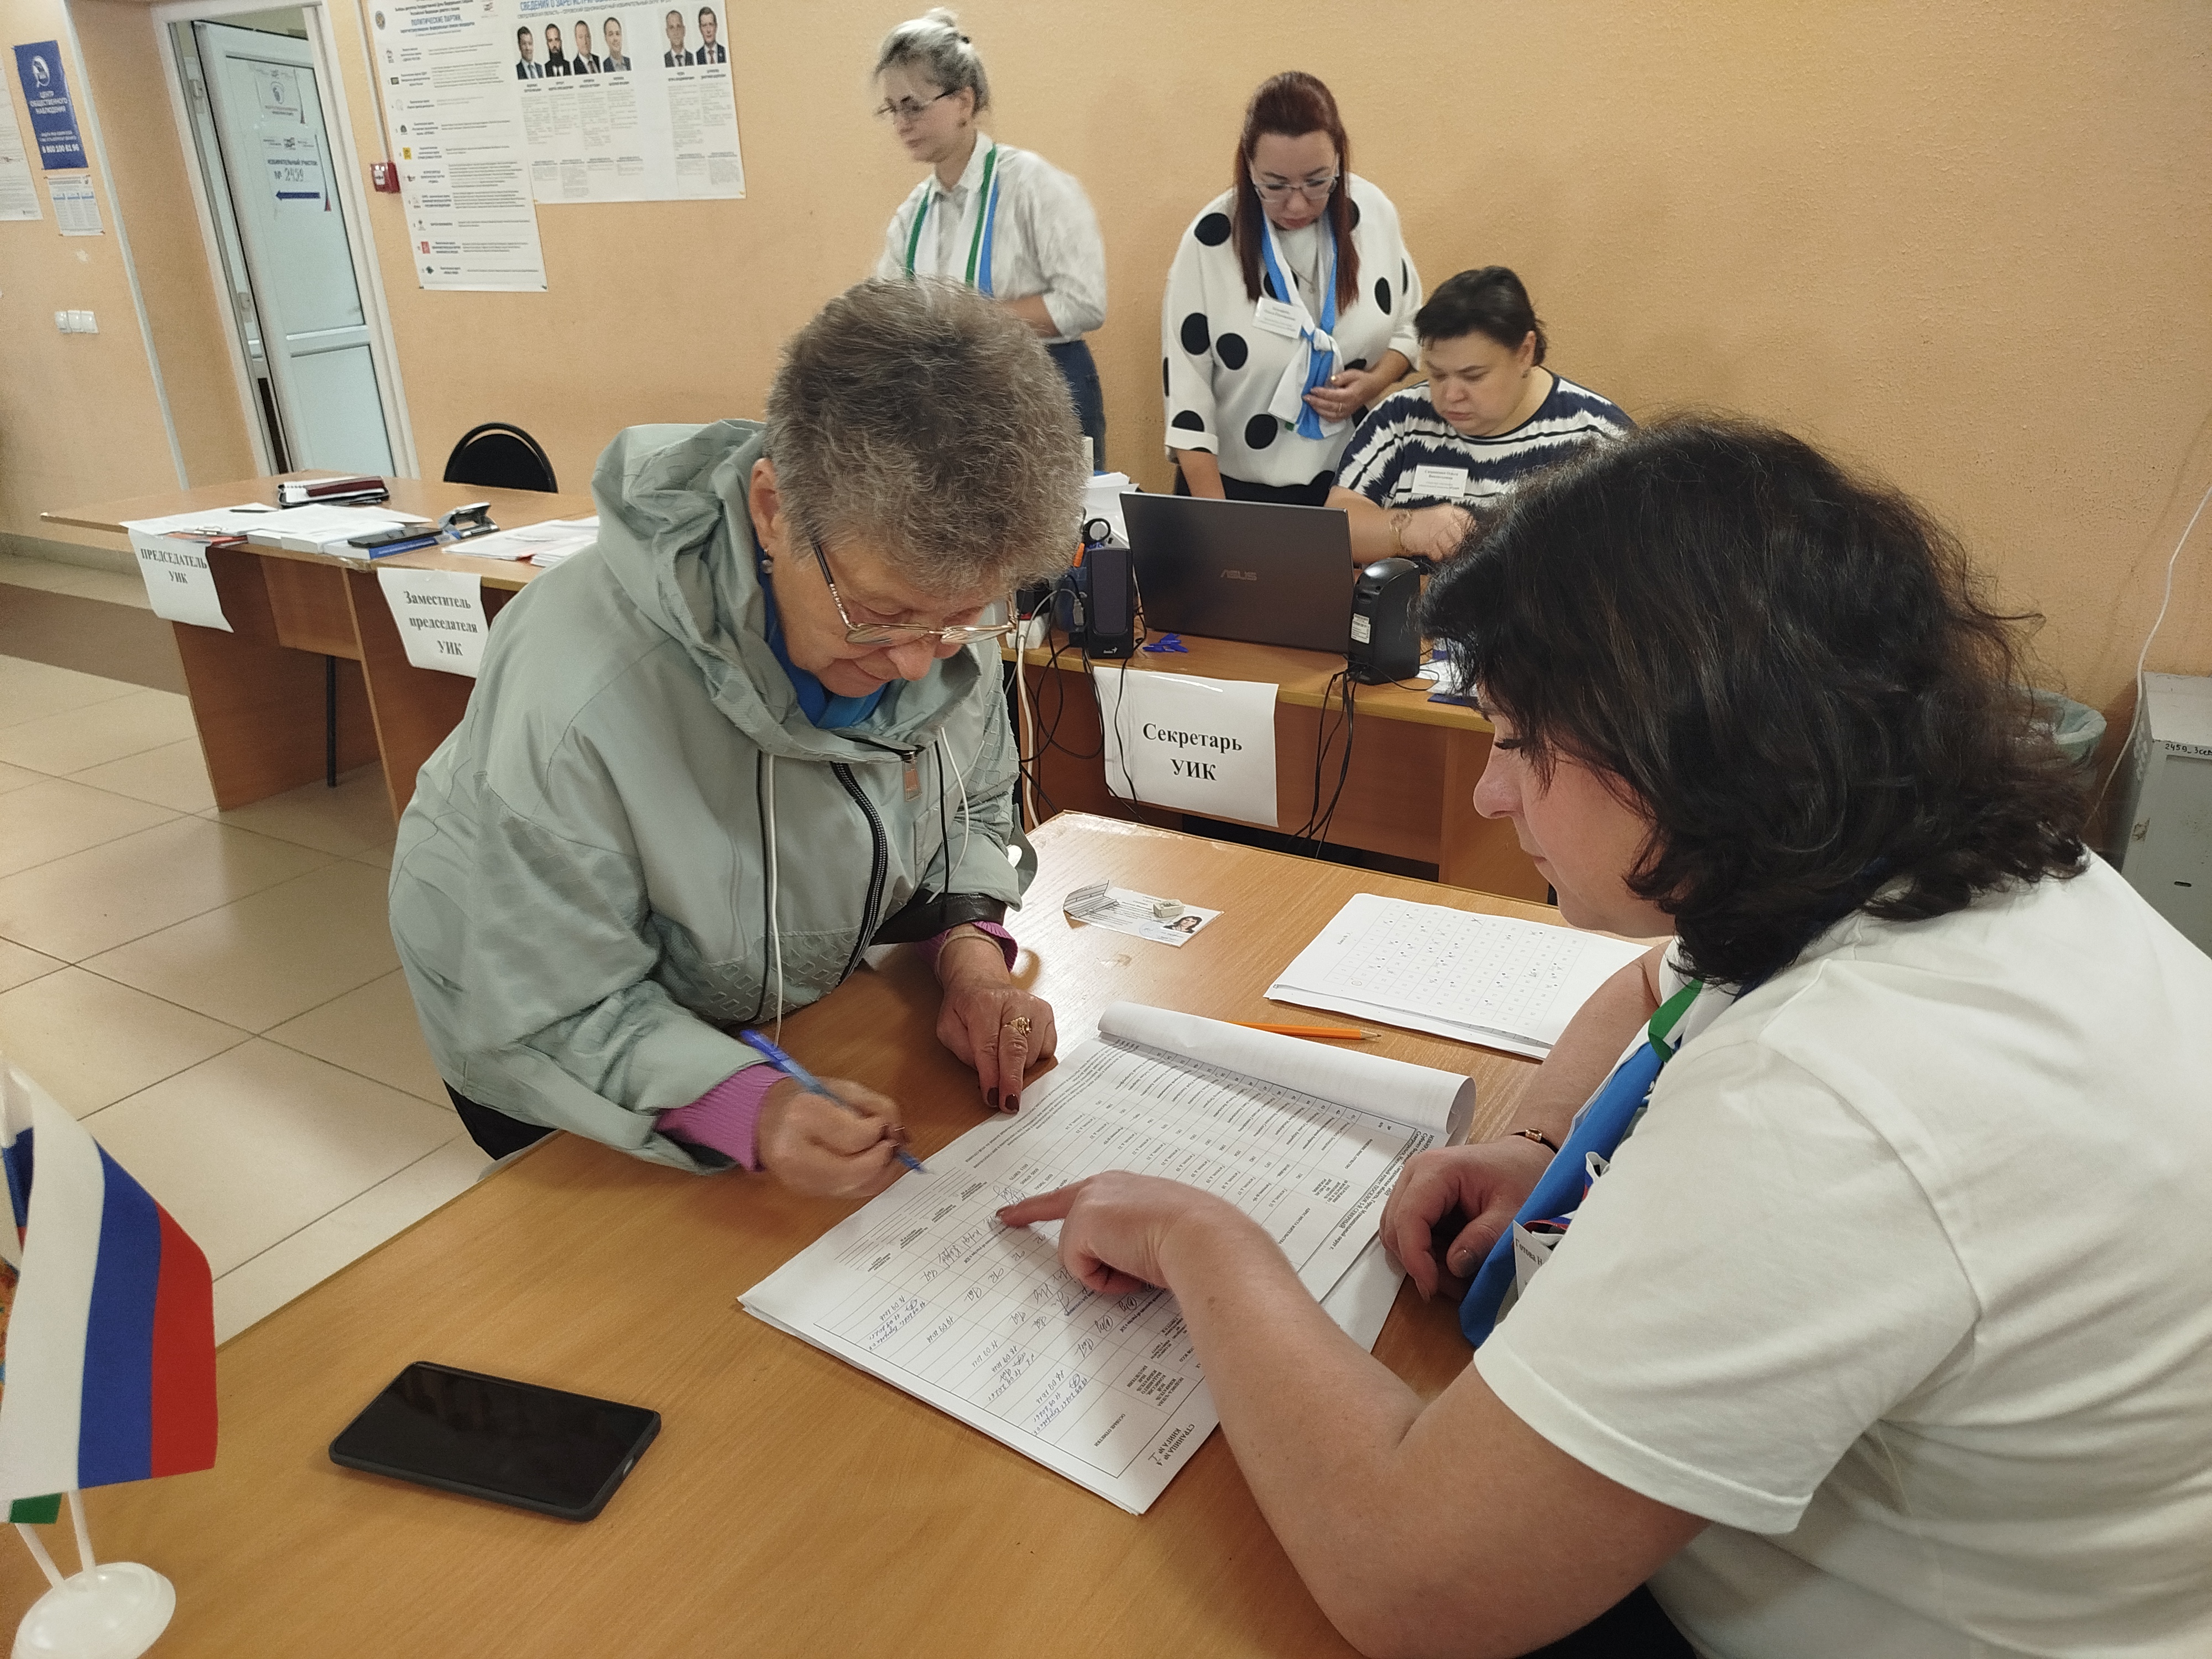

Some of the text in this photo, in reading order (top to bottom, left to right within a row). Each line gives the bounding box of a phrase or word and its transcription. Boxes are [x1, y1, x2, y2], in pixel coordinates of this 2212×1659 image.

[140, 548, 207, 569] ПРЕДСЕДАТЕЛЬ
[168, 570, 188, 583] УИК
[1220, 569, 1257, 581] ASUS
[404, 590, 471, 609] Заместитель
[409, 617, 478, 633] председателя
[437, 640, 463, 656] УИК
[1142, 723, 1243, 754] Секретарь
[1170, 758, 1217, 781] УИК
[1515, 1238, 1536, 1260] Готова
[1161, 1427, 1182, 1447] КНИГА
[1167, 1423, 1196, 1453] СТРАНИЦА
